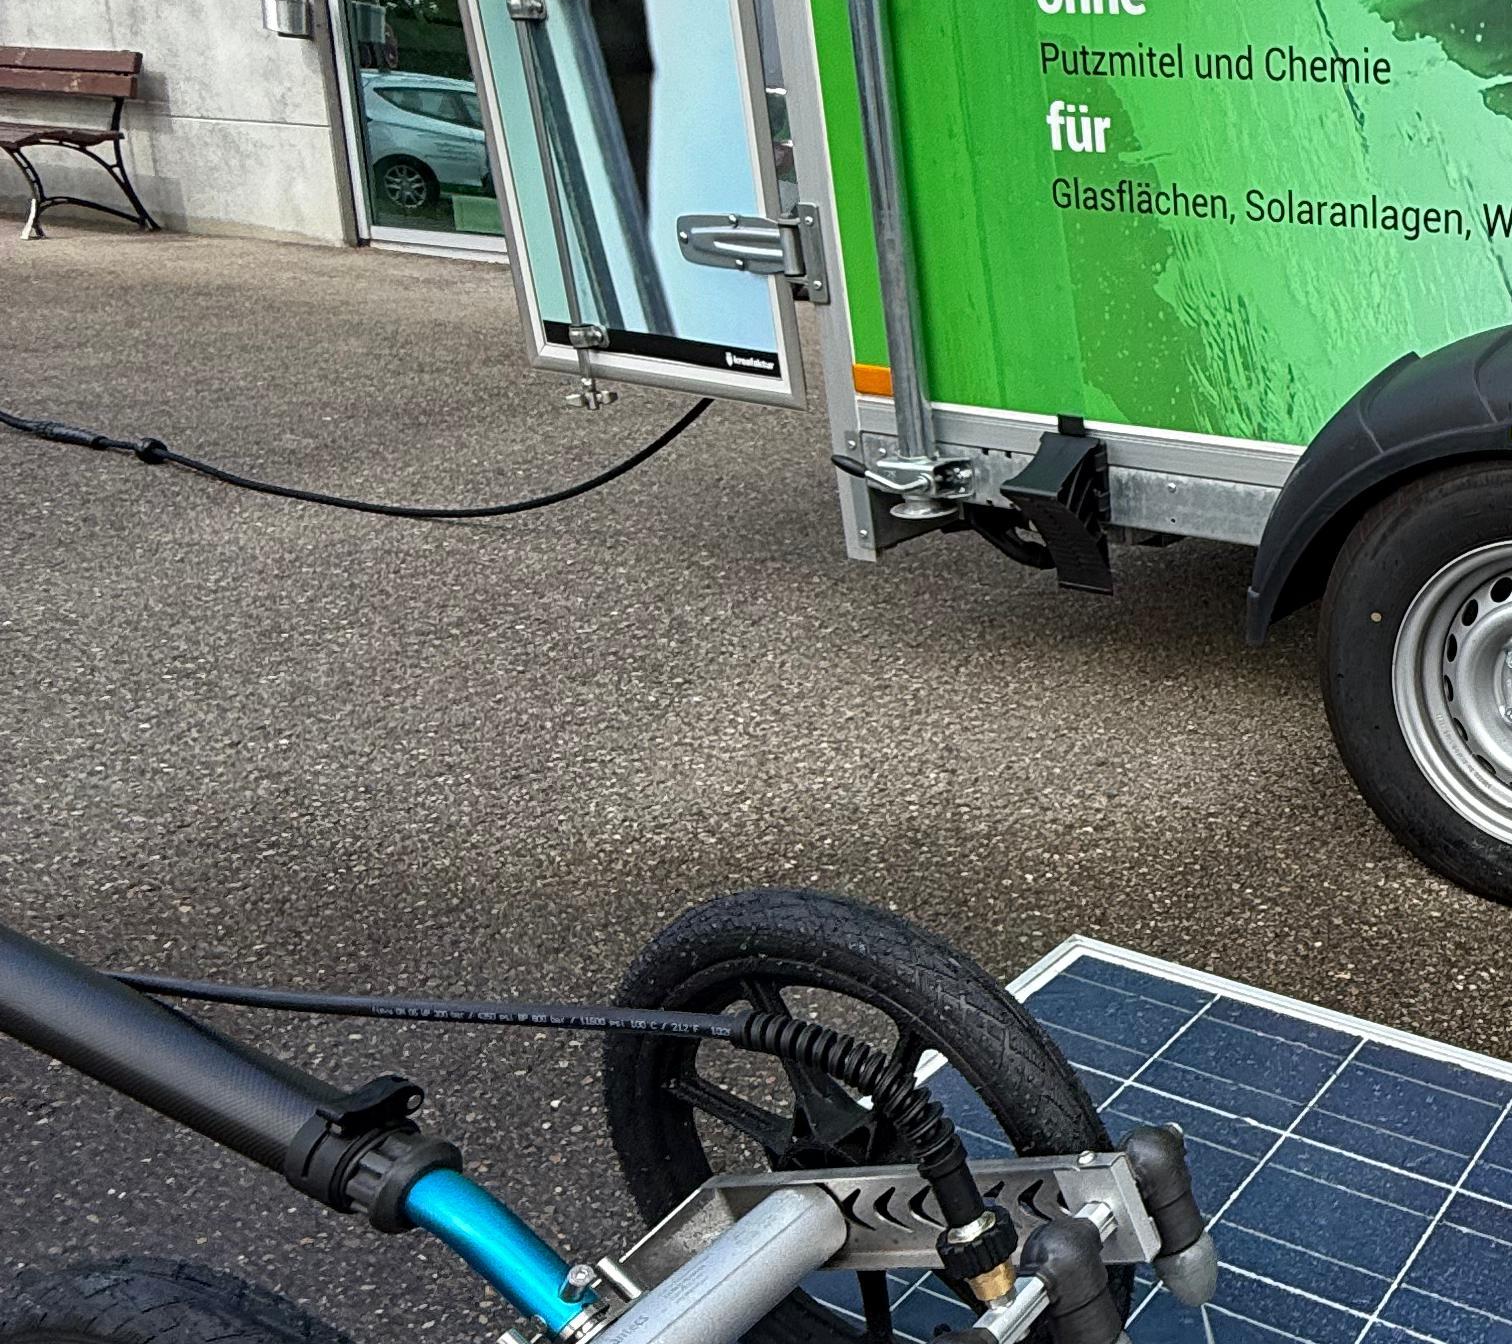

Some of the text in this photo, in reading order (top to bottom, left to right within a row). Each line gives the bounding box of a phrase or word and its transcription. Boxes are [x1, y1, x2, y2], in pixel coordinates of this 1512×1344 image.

[1041, 42, 1392, 86] Putzmitel und Chemie
[1047, 100, 1110, 154] für
[1052, 178, 1236, 225] Glasflächen,
[1245, 189, 1472, 241] Solaranlagen,
[550, 1014, 564, 1024] bar
